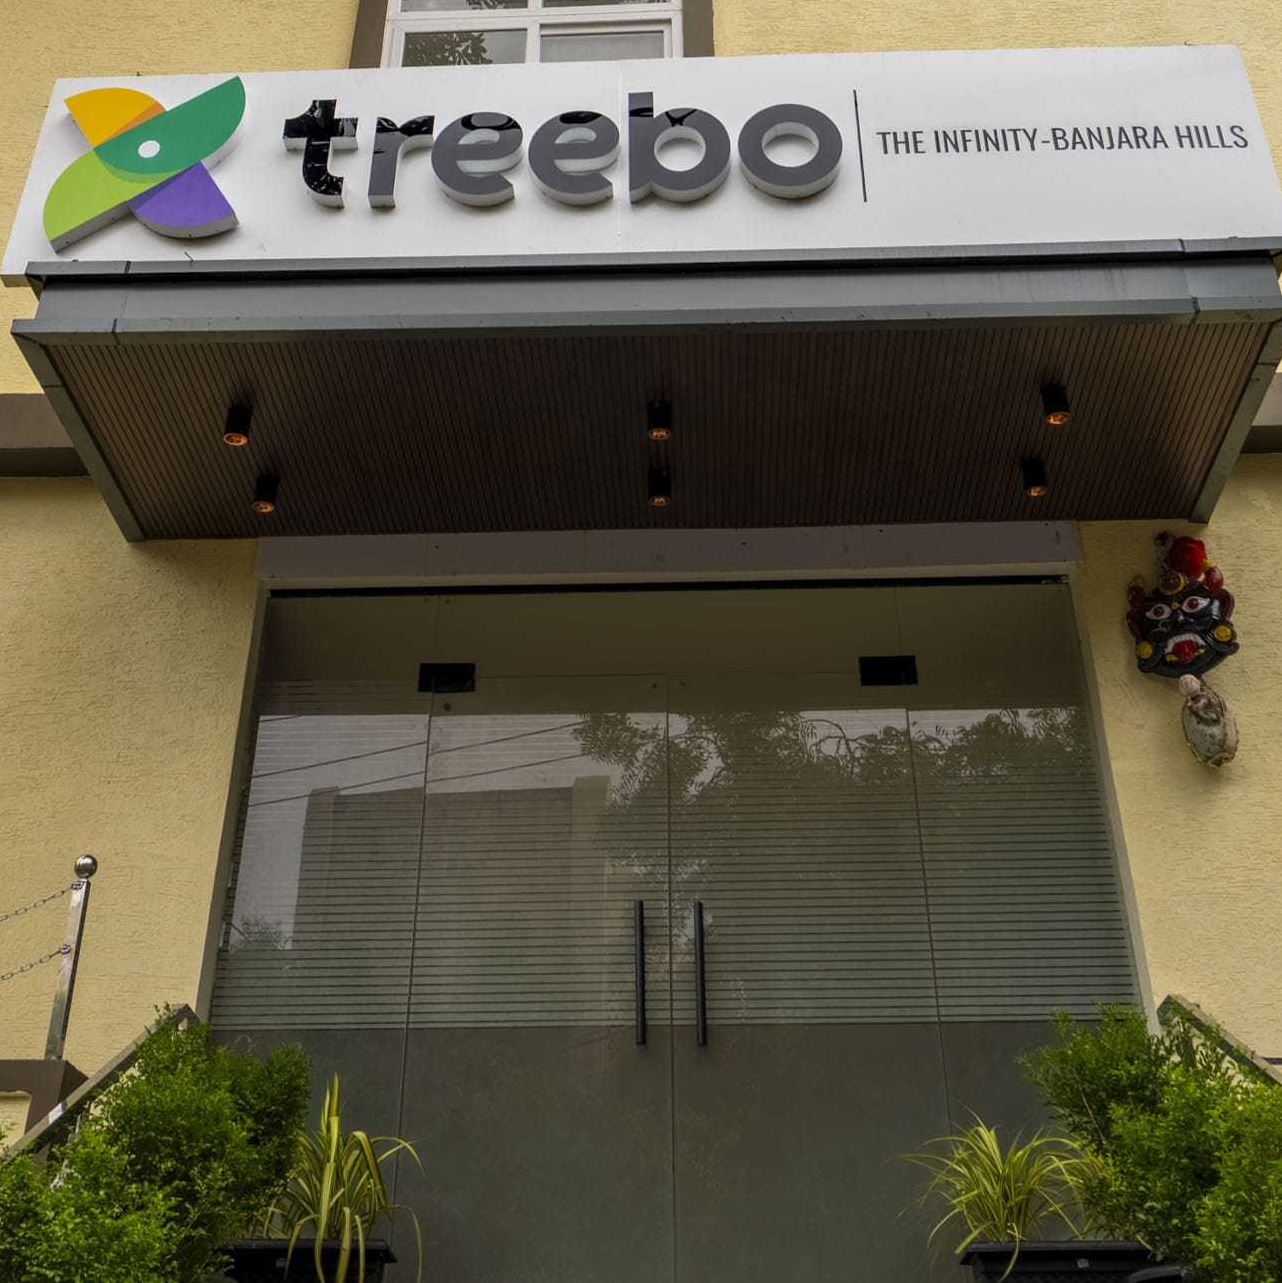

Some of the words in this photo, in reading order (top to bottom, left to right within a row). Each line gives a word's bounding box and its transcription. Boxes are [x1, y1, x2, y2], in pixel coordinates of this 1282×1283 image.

[283, 91, 843, 208] treebo
[876, 131, 926, 155] THE
[933, 126, 1169, 153] INFINITY-BANJARA
[1174, 125, 1249, 150] HILLS
